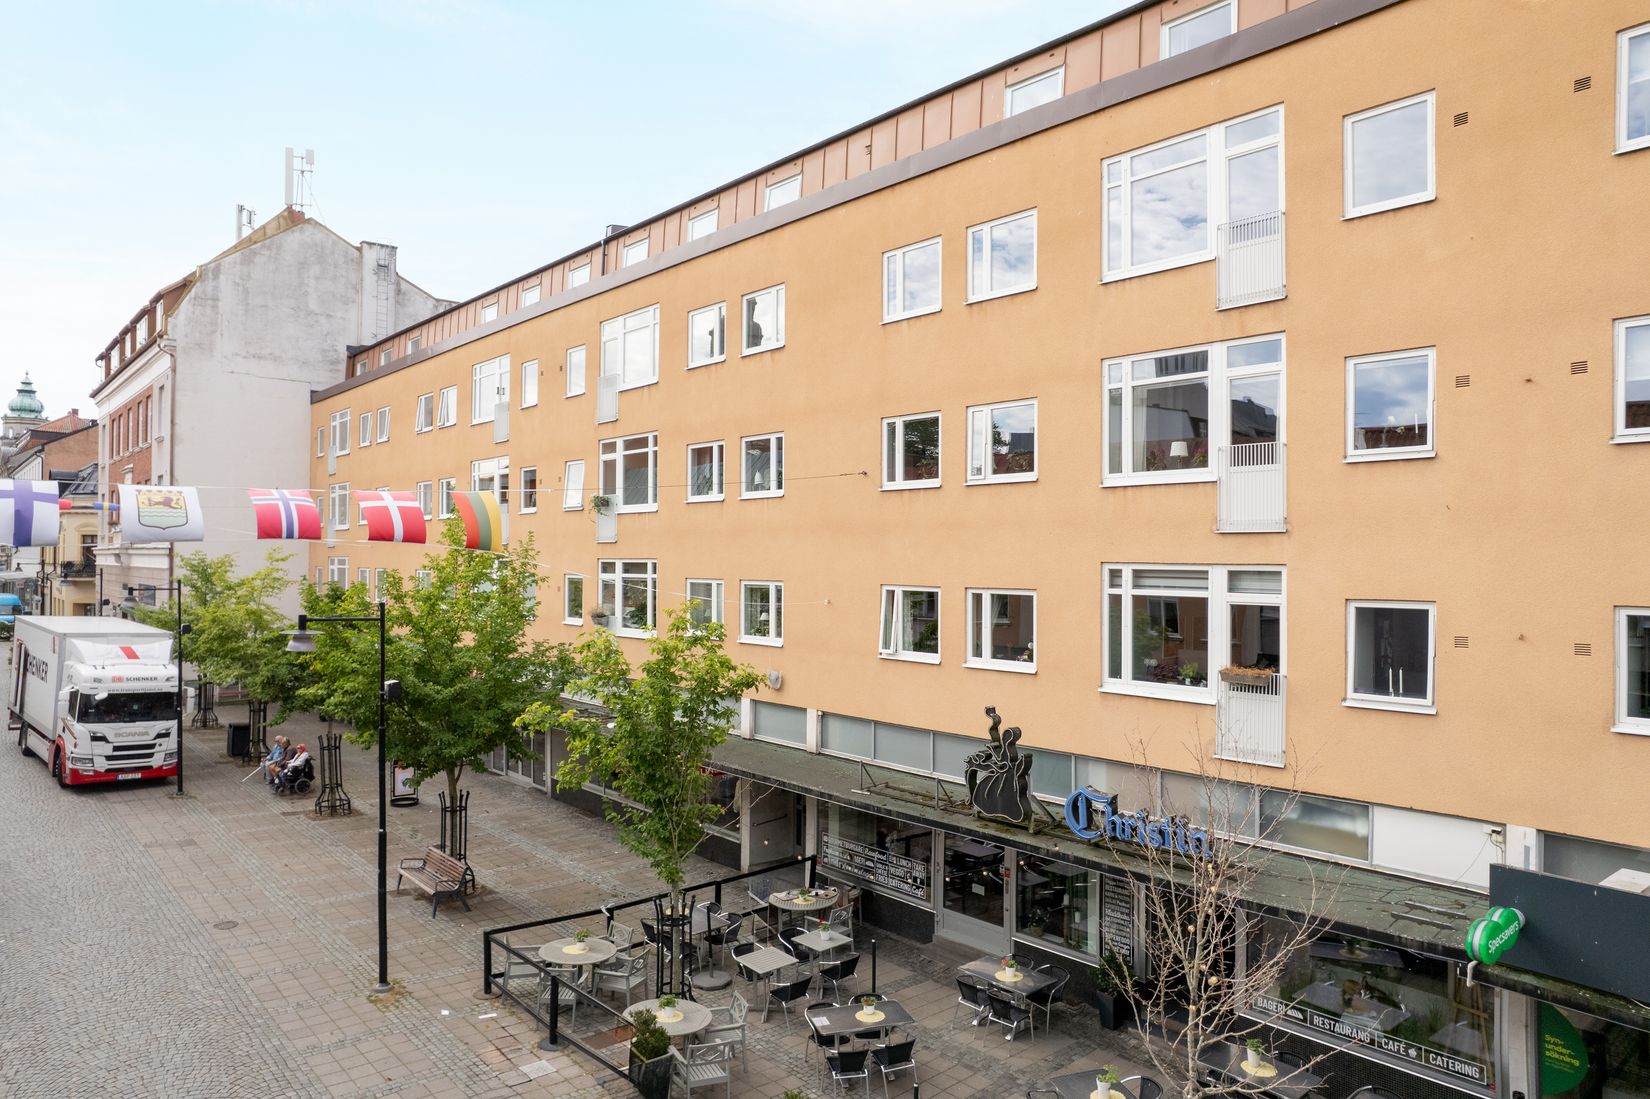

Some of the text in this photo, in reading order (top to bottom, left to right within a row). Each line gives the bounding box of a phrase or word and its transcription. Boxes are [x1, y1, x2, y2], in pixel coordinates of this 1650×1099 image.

[114, 730, 150, 738] SCANIA
[896, 857, 912, 869] LUNCH
[912, 862, 925, 873] TAKE
[912, 870, 925, 880] AWAY
[889, 877, 911, 892] CATERING
[912, 885, 925, 897] Café
[1488, 921, 1519, 954] Specsavers
[1257, 997, 1286, 1015] BAGERI
[1313, 1015, 1370, 1043] RESTAURANG
[1544, 1034, 1564, 1045] Syn-
[1381, 1038, 1406, 1055] CAFÉ
[1545, 1043, 1575, 1055] under-
[1545, 1050, 1580, 1067] sökning
[1429, 1053, 1480, 1079] CATERING
